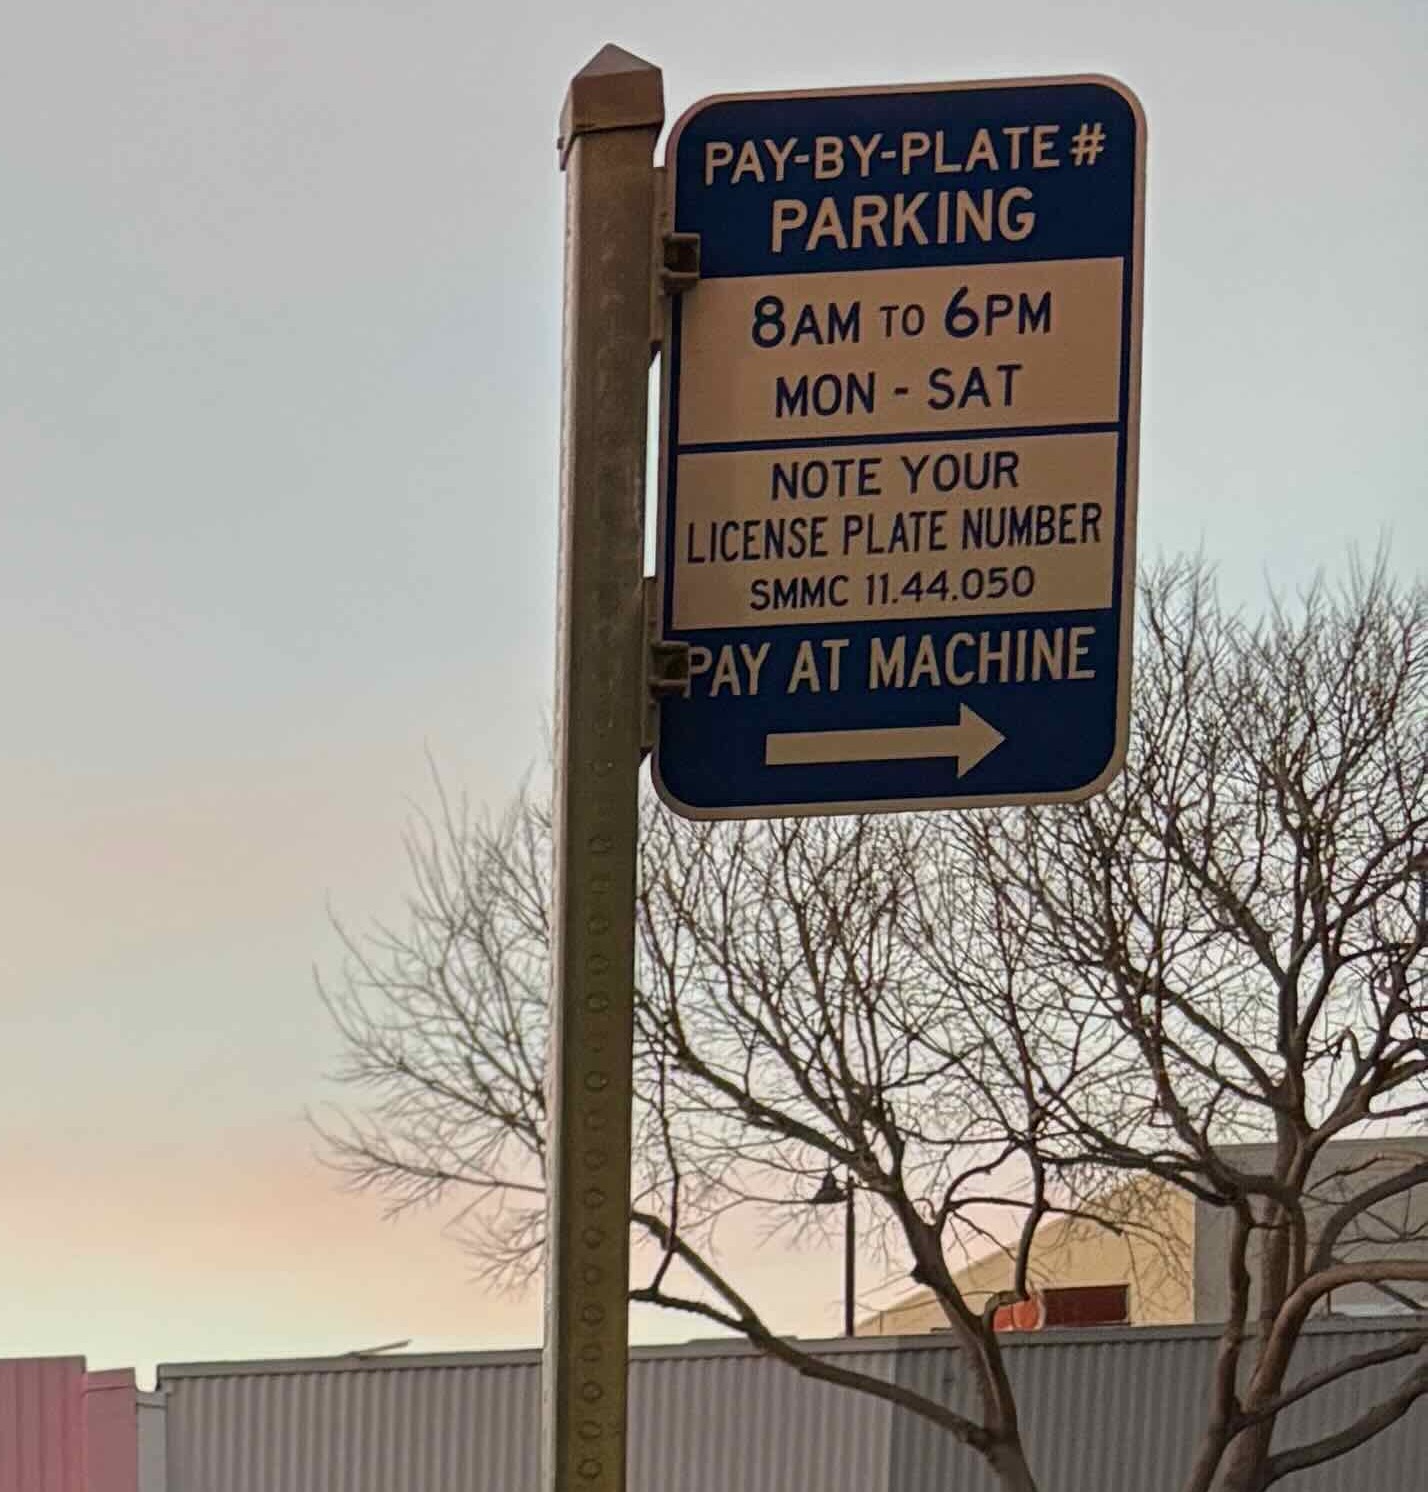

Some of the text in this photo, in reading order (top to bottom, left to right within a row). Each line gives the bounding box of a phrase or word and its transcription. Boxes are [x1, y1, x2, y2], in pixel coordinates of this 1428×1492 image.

[704, 122, 1106, 185] PAY-BY-PLATE #
[771, 187, 1036, 252] PARKING
[751, 286, 1053, 348] 8AM TO 6PM
[775, 370, 876, 419] MON
[927, 364, 1023, 410] SAT
[771, 450, 1020, 501] NOTE YOUR
[687, 502, 1101, 564] LICENSE PLATE NUMBER
[750, 565, 1036, 611] SMMC 11.44.050
[688, 625, 1097, 698] PAY AT MACHINE
